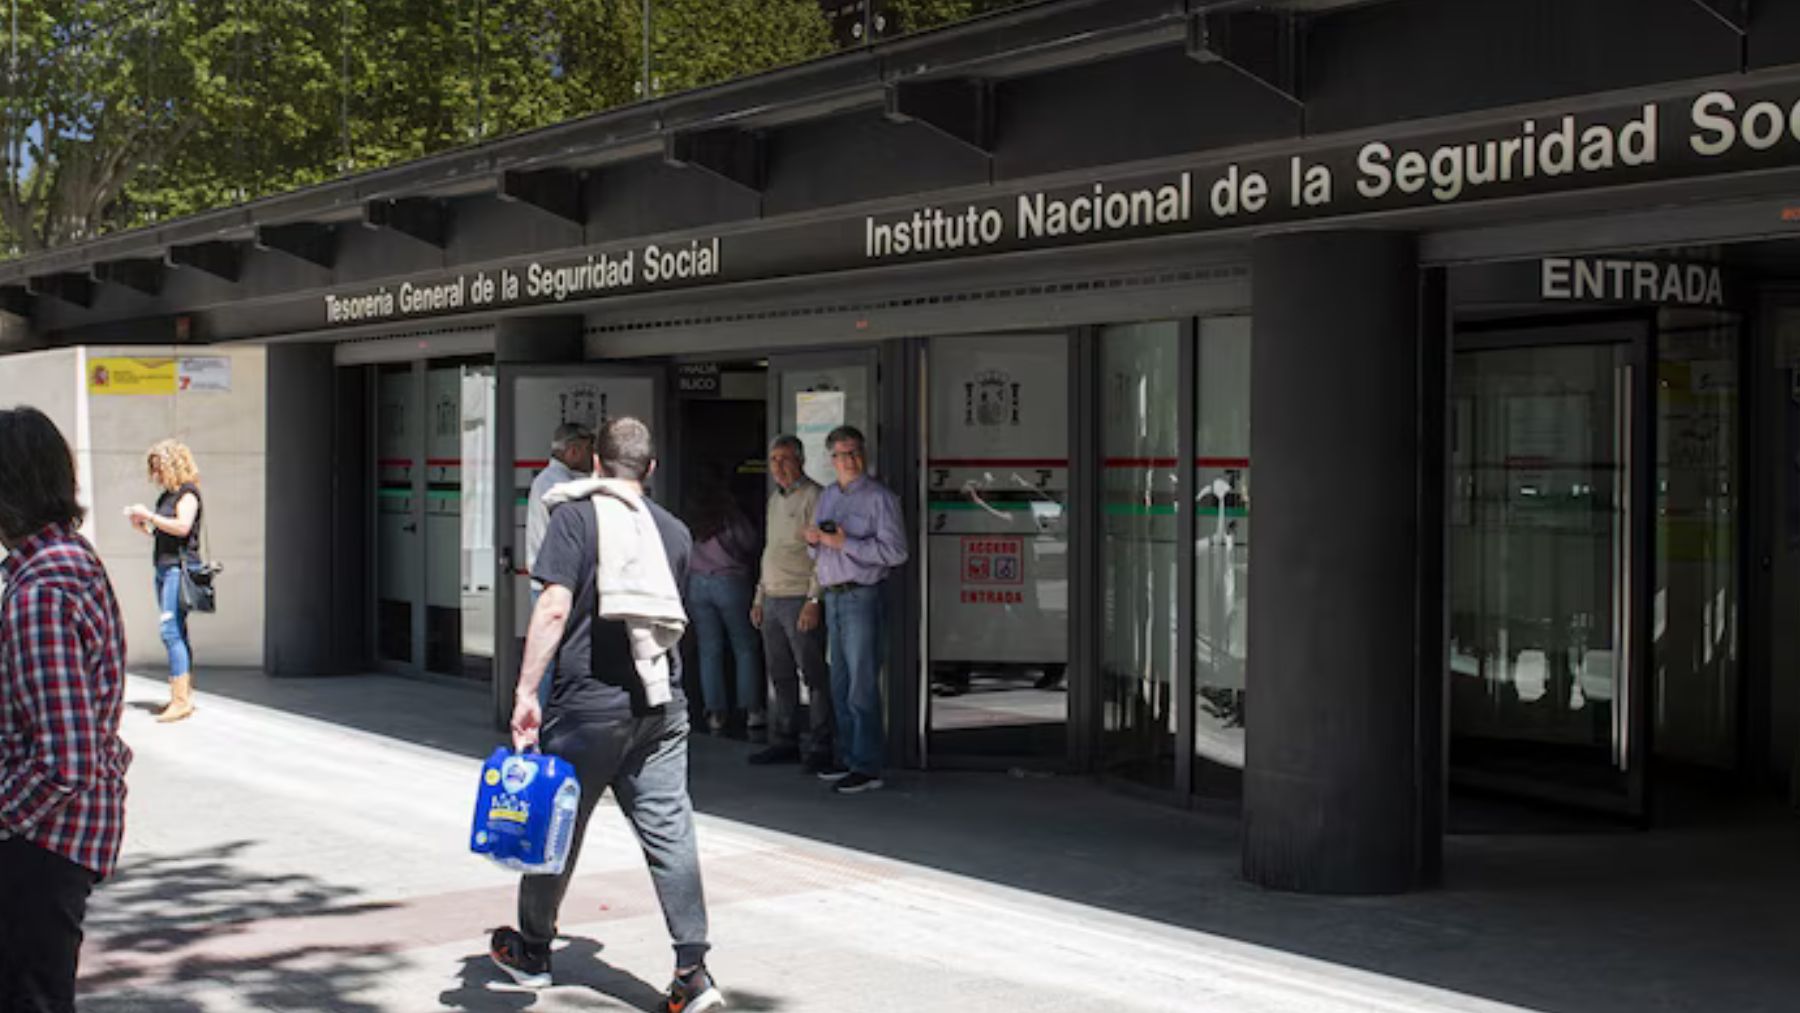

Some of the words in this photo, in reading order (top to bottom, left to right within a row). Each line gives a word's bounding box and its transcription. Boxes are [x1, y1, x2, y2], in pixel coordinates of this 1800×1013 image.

[866, 205, 1003, 257] Instituto
[1017, 172, 1191, 239] Nacional
[1210, 164, 1268, 217] de
[1290, 156, 1332, 207] la
[1356, 103, 1658, 201] Seguridad
[1689, 91, 1800, 156] So
[400, 275, 464, 313] General
[471, 271, 495, 304] de
[502, 268, 519, 301] la
[527, 250, 634, 300] Seguridad
[643, 237, 719, 282] Social
[1541, 257, 1723, 305] ENTRADA
[960, 590, 1023, 604] ENTRADA
